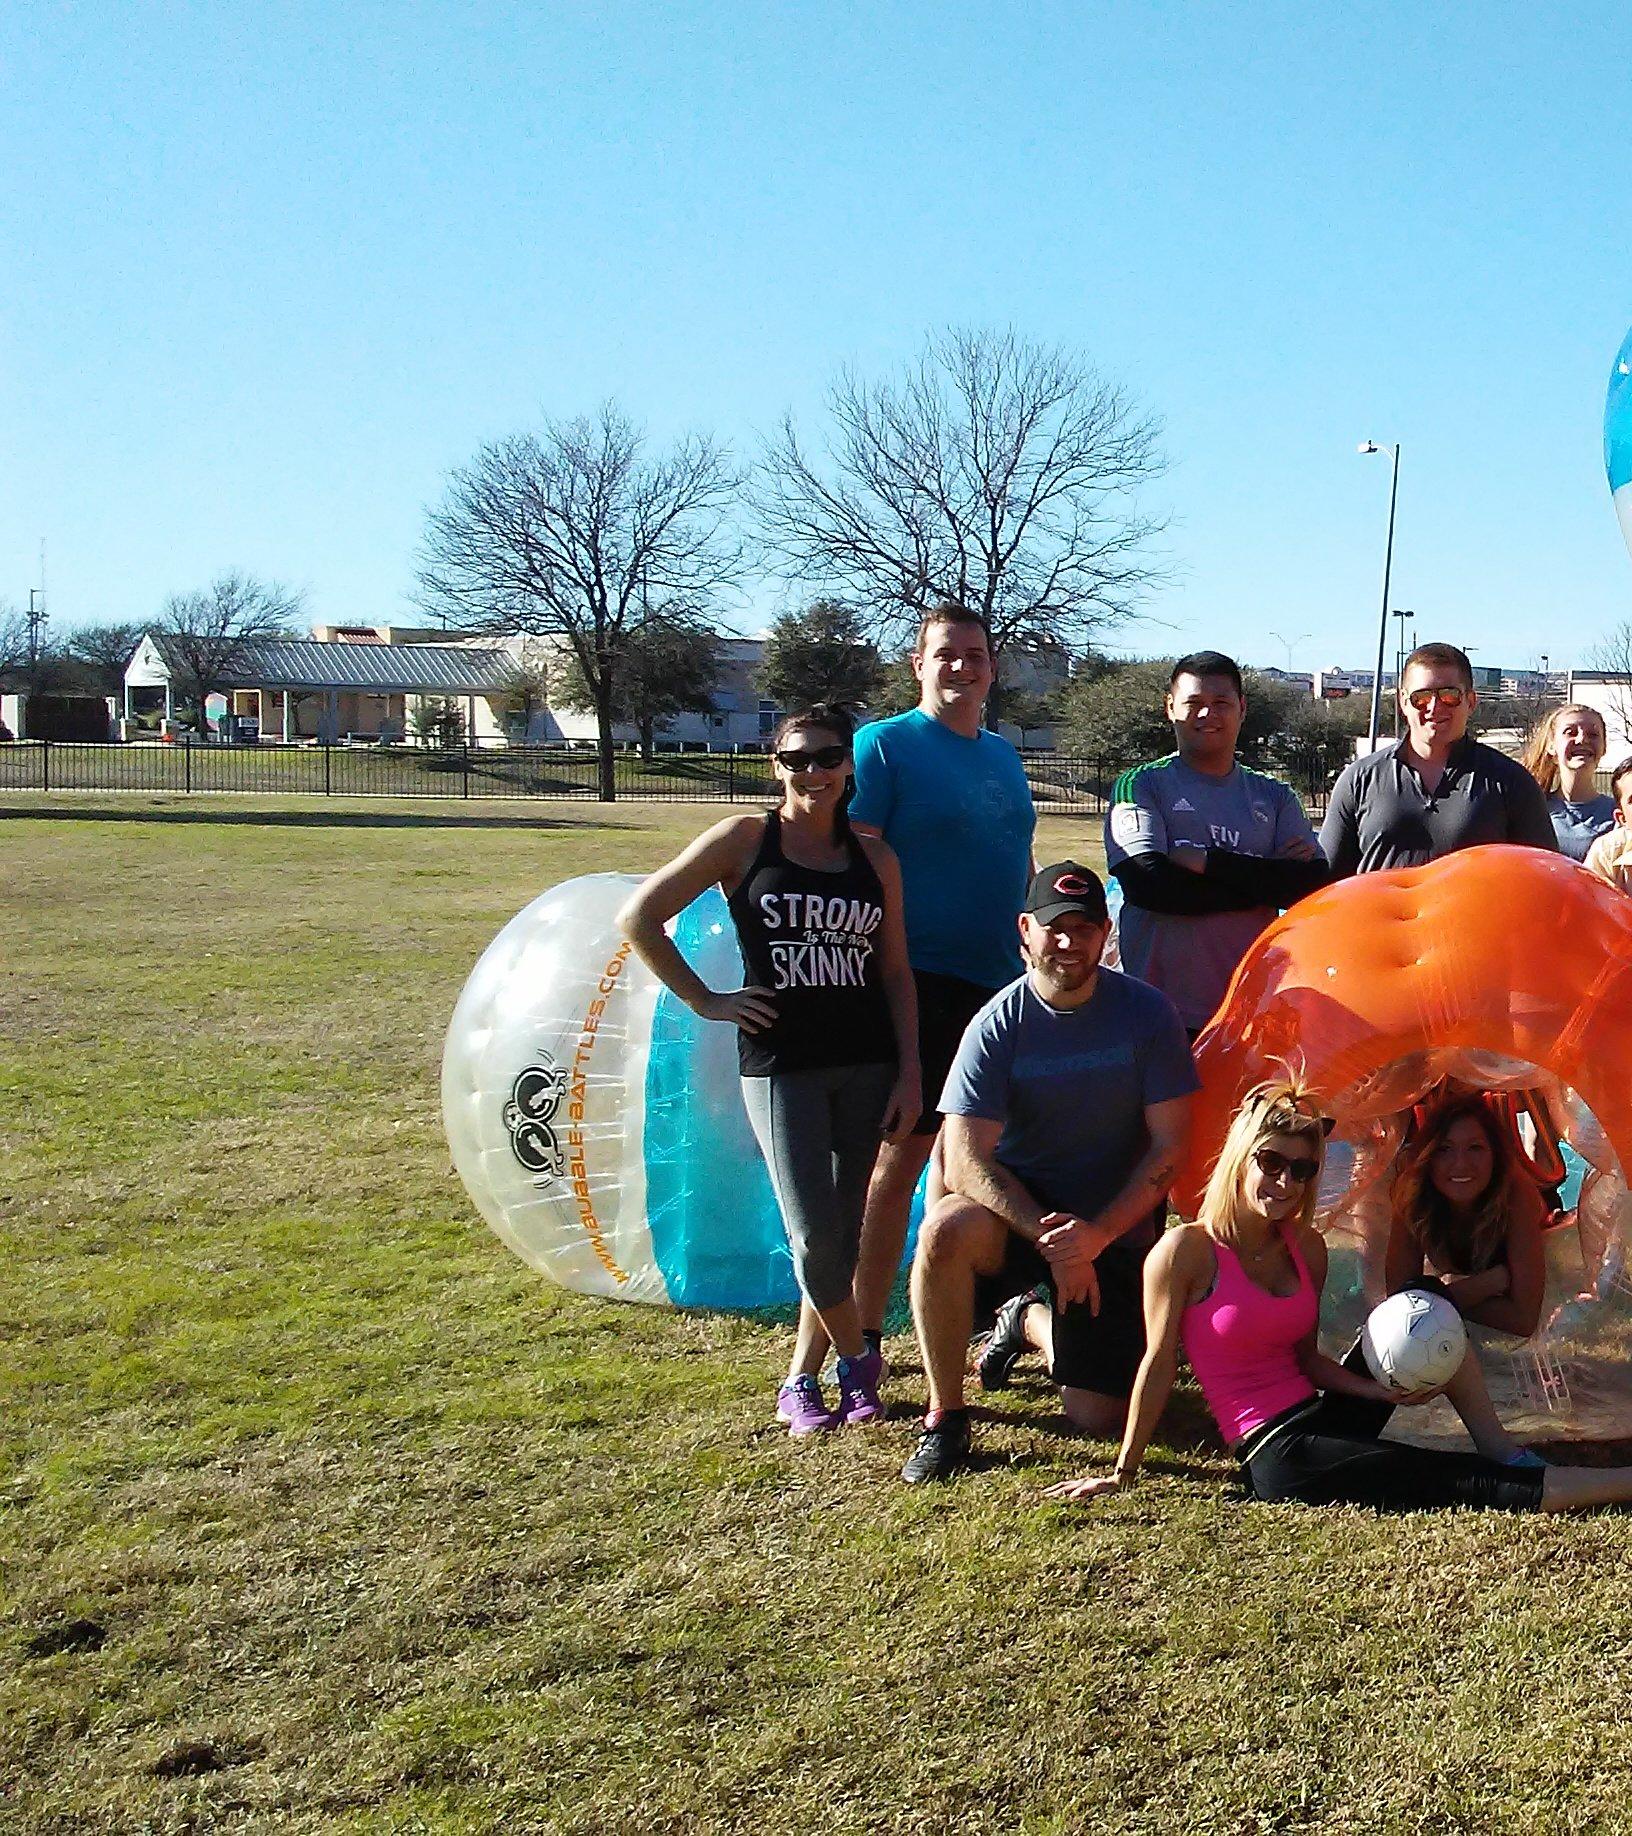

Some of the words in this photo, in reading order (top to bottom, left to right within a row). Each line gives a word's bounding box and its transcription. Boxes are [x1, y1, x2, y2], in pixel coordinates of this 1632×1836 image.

[760, 893, 882, 934] STRONG
[771, 946, 867, 989] SKINNY
[569, 940, 632, 1284] WWW.BUBBLE-BATTLES.COM
